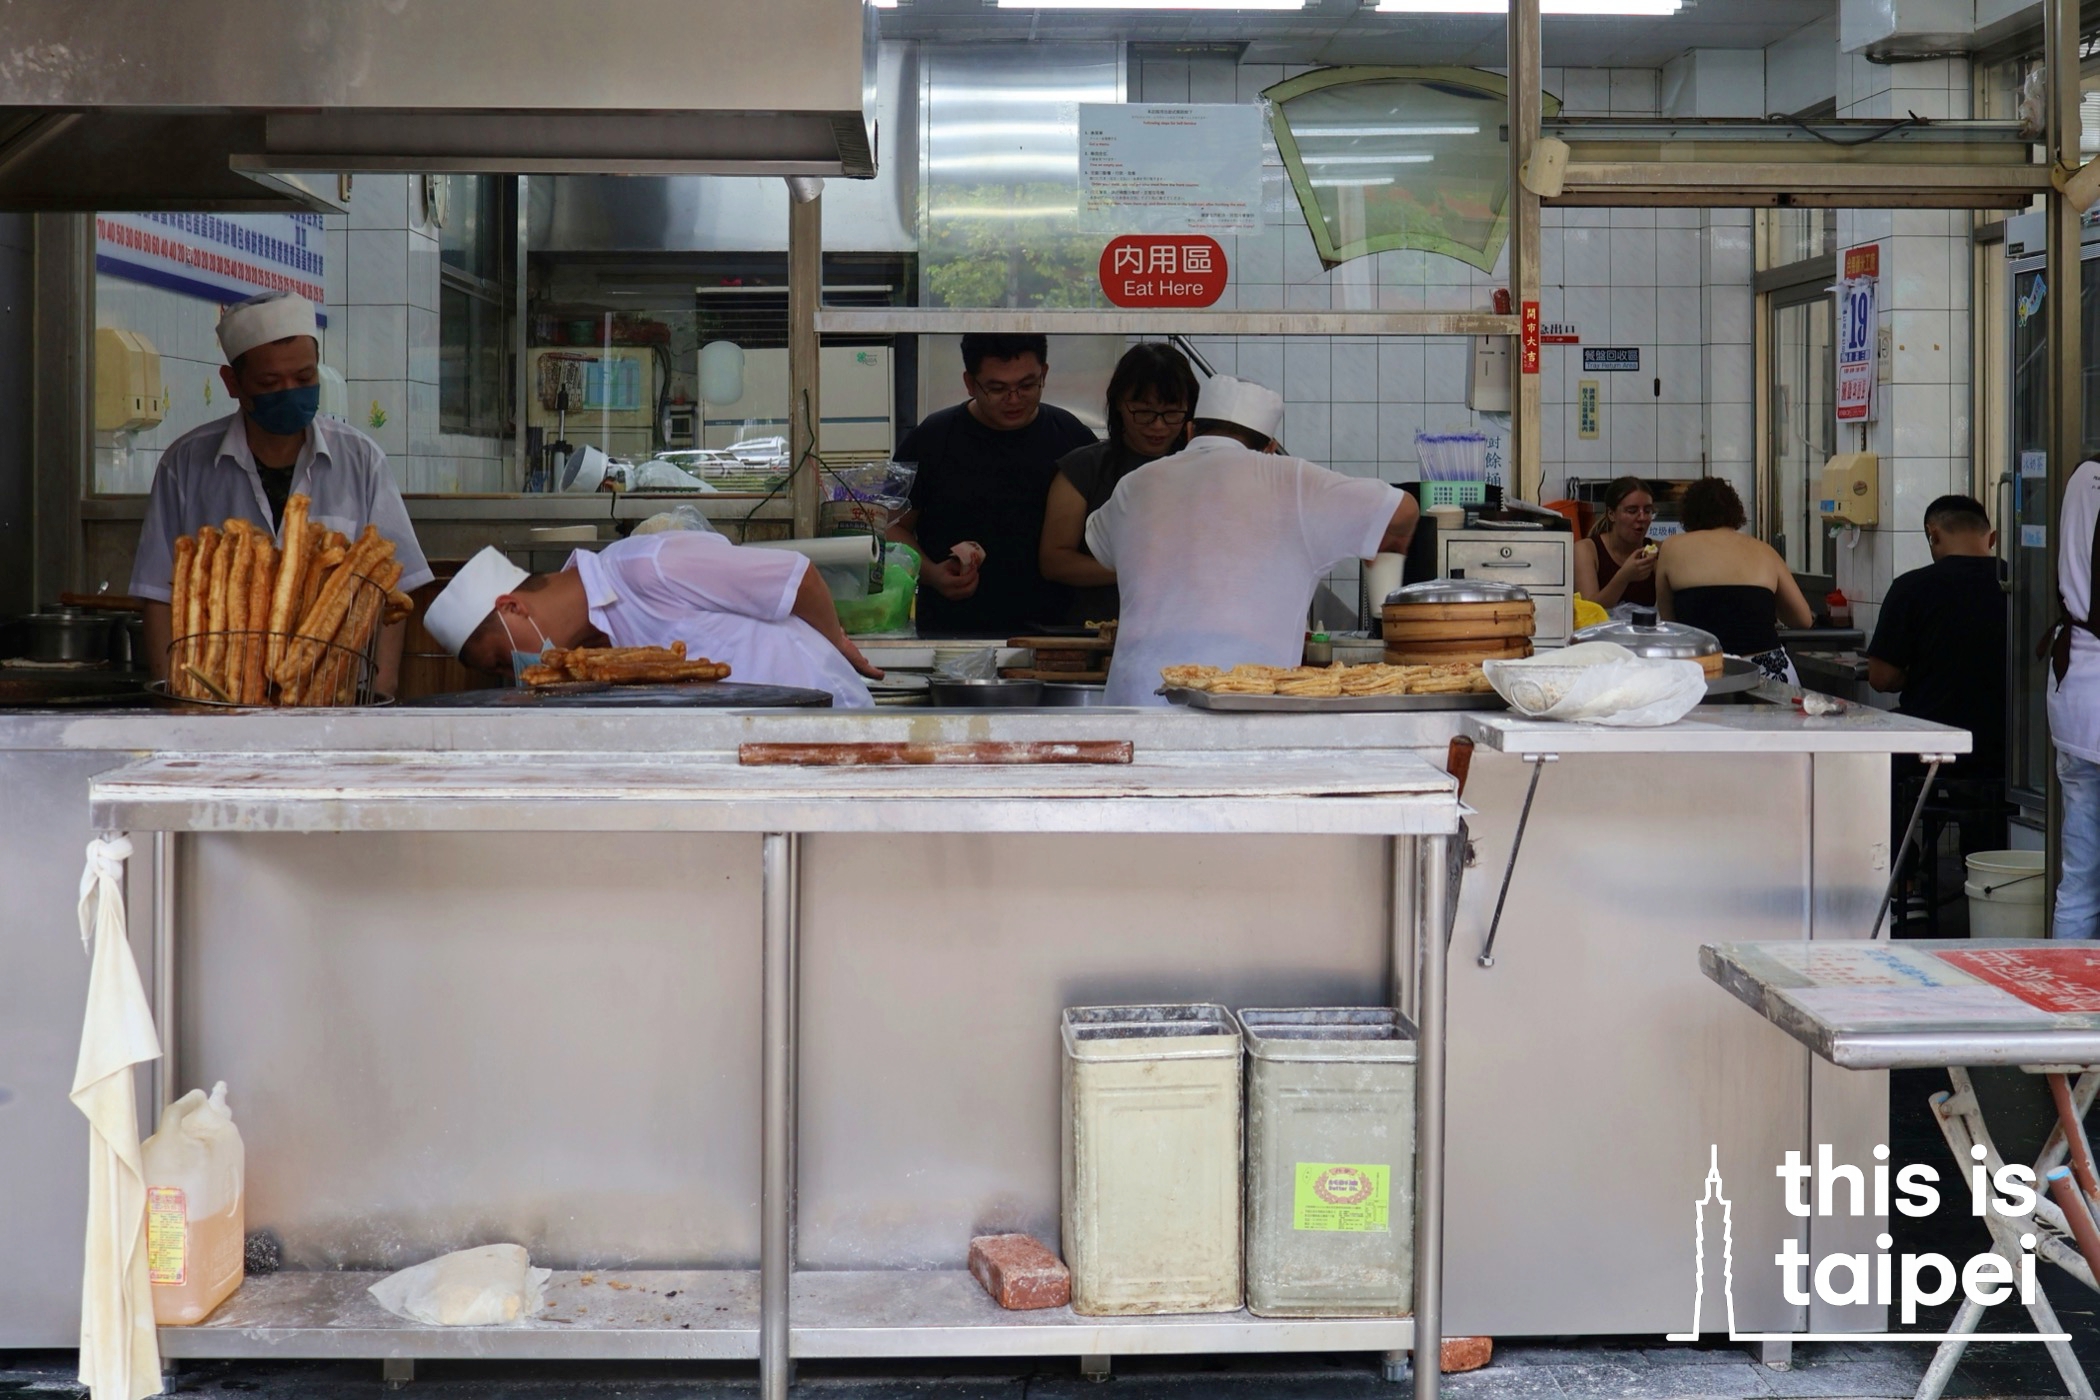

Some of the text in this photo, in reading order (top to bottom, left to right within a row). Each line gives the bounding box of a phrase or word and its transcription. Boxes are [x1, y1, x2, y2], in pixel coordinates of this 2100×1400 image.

[1124, 280, 1204, 296] Eat Here
[1849, 292, 1868, 349] 19
[1526, 308, 1537, 362] 開市大吉
[1585, 350, 1638, 361] 餐盤回收區
[1587, 362, 1601, 370] Tray
